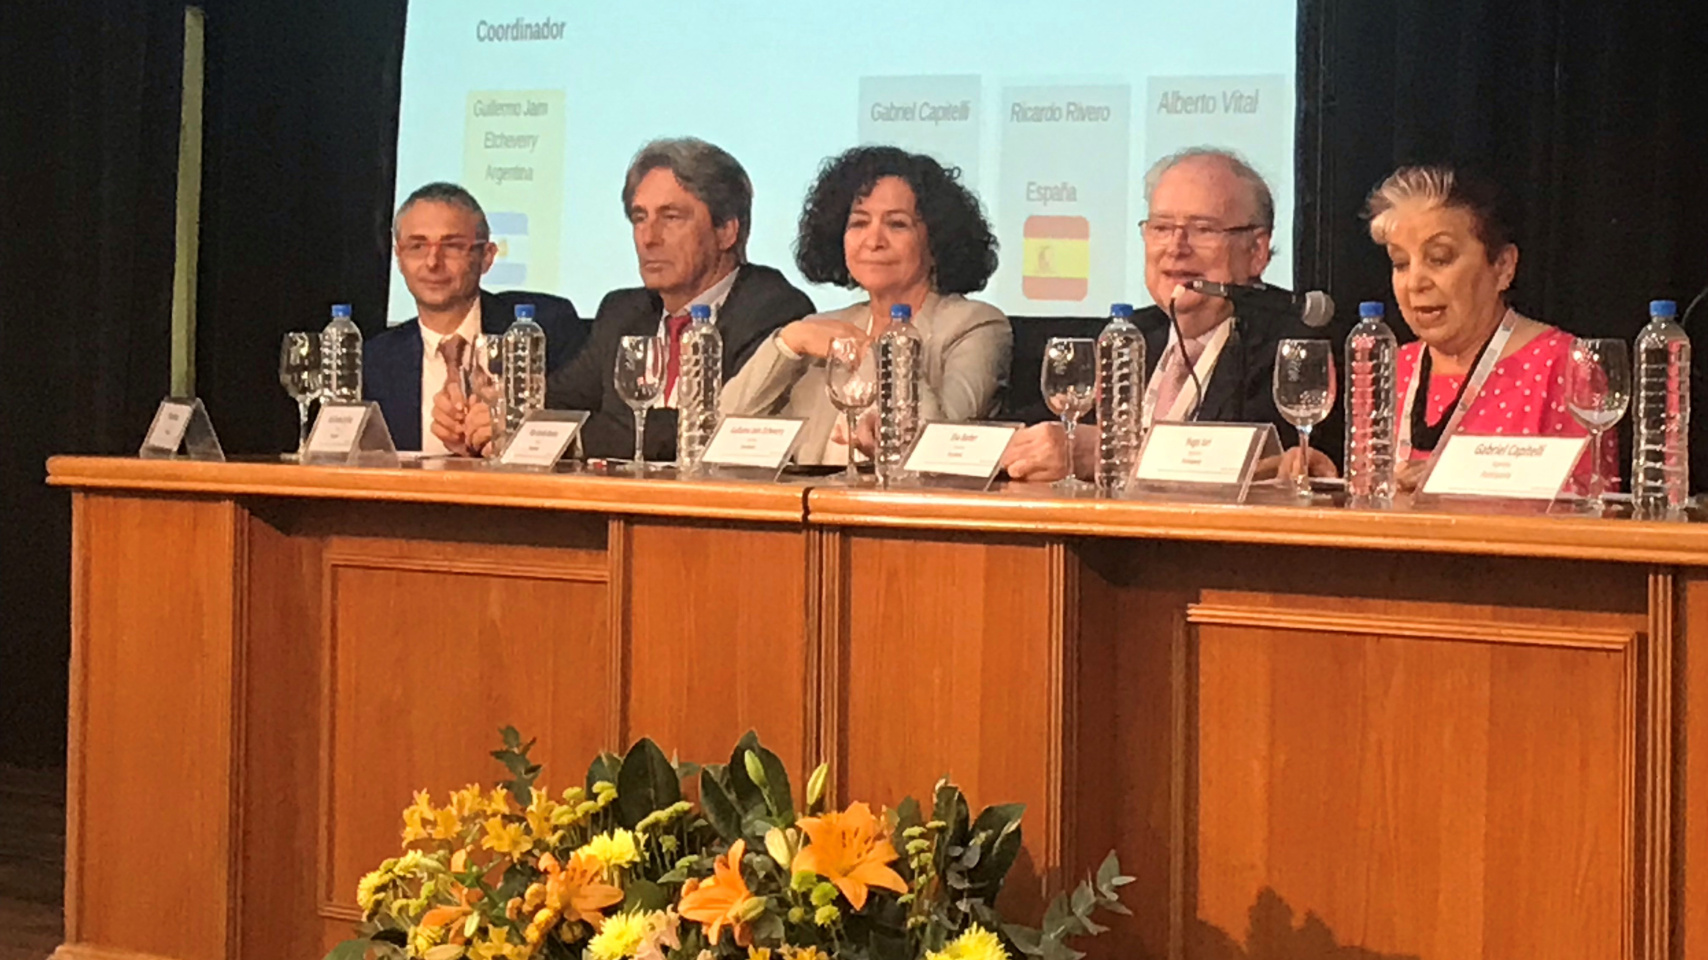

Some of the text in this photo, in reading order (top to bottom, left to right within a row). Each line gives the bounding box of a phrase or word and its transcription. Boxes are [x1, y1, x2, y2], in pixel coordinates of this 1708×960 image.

[477, 16, 566, 42] Coordinador
[871, 102, 917, 121] Gabriel
[1009, 102, 1110, 122] Ricardo Rivero
[1157, 88, 1259, 115] Alberto Vital
[1026, 181, 1077, 206] España
[1474, 443, 1508, 455] Gabriel
